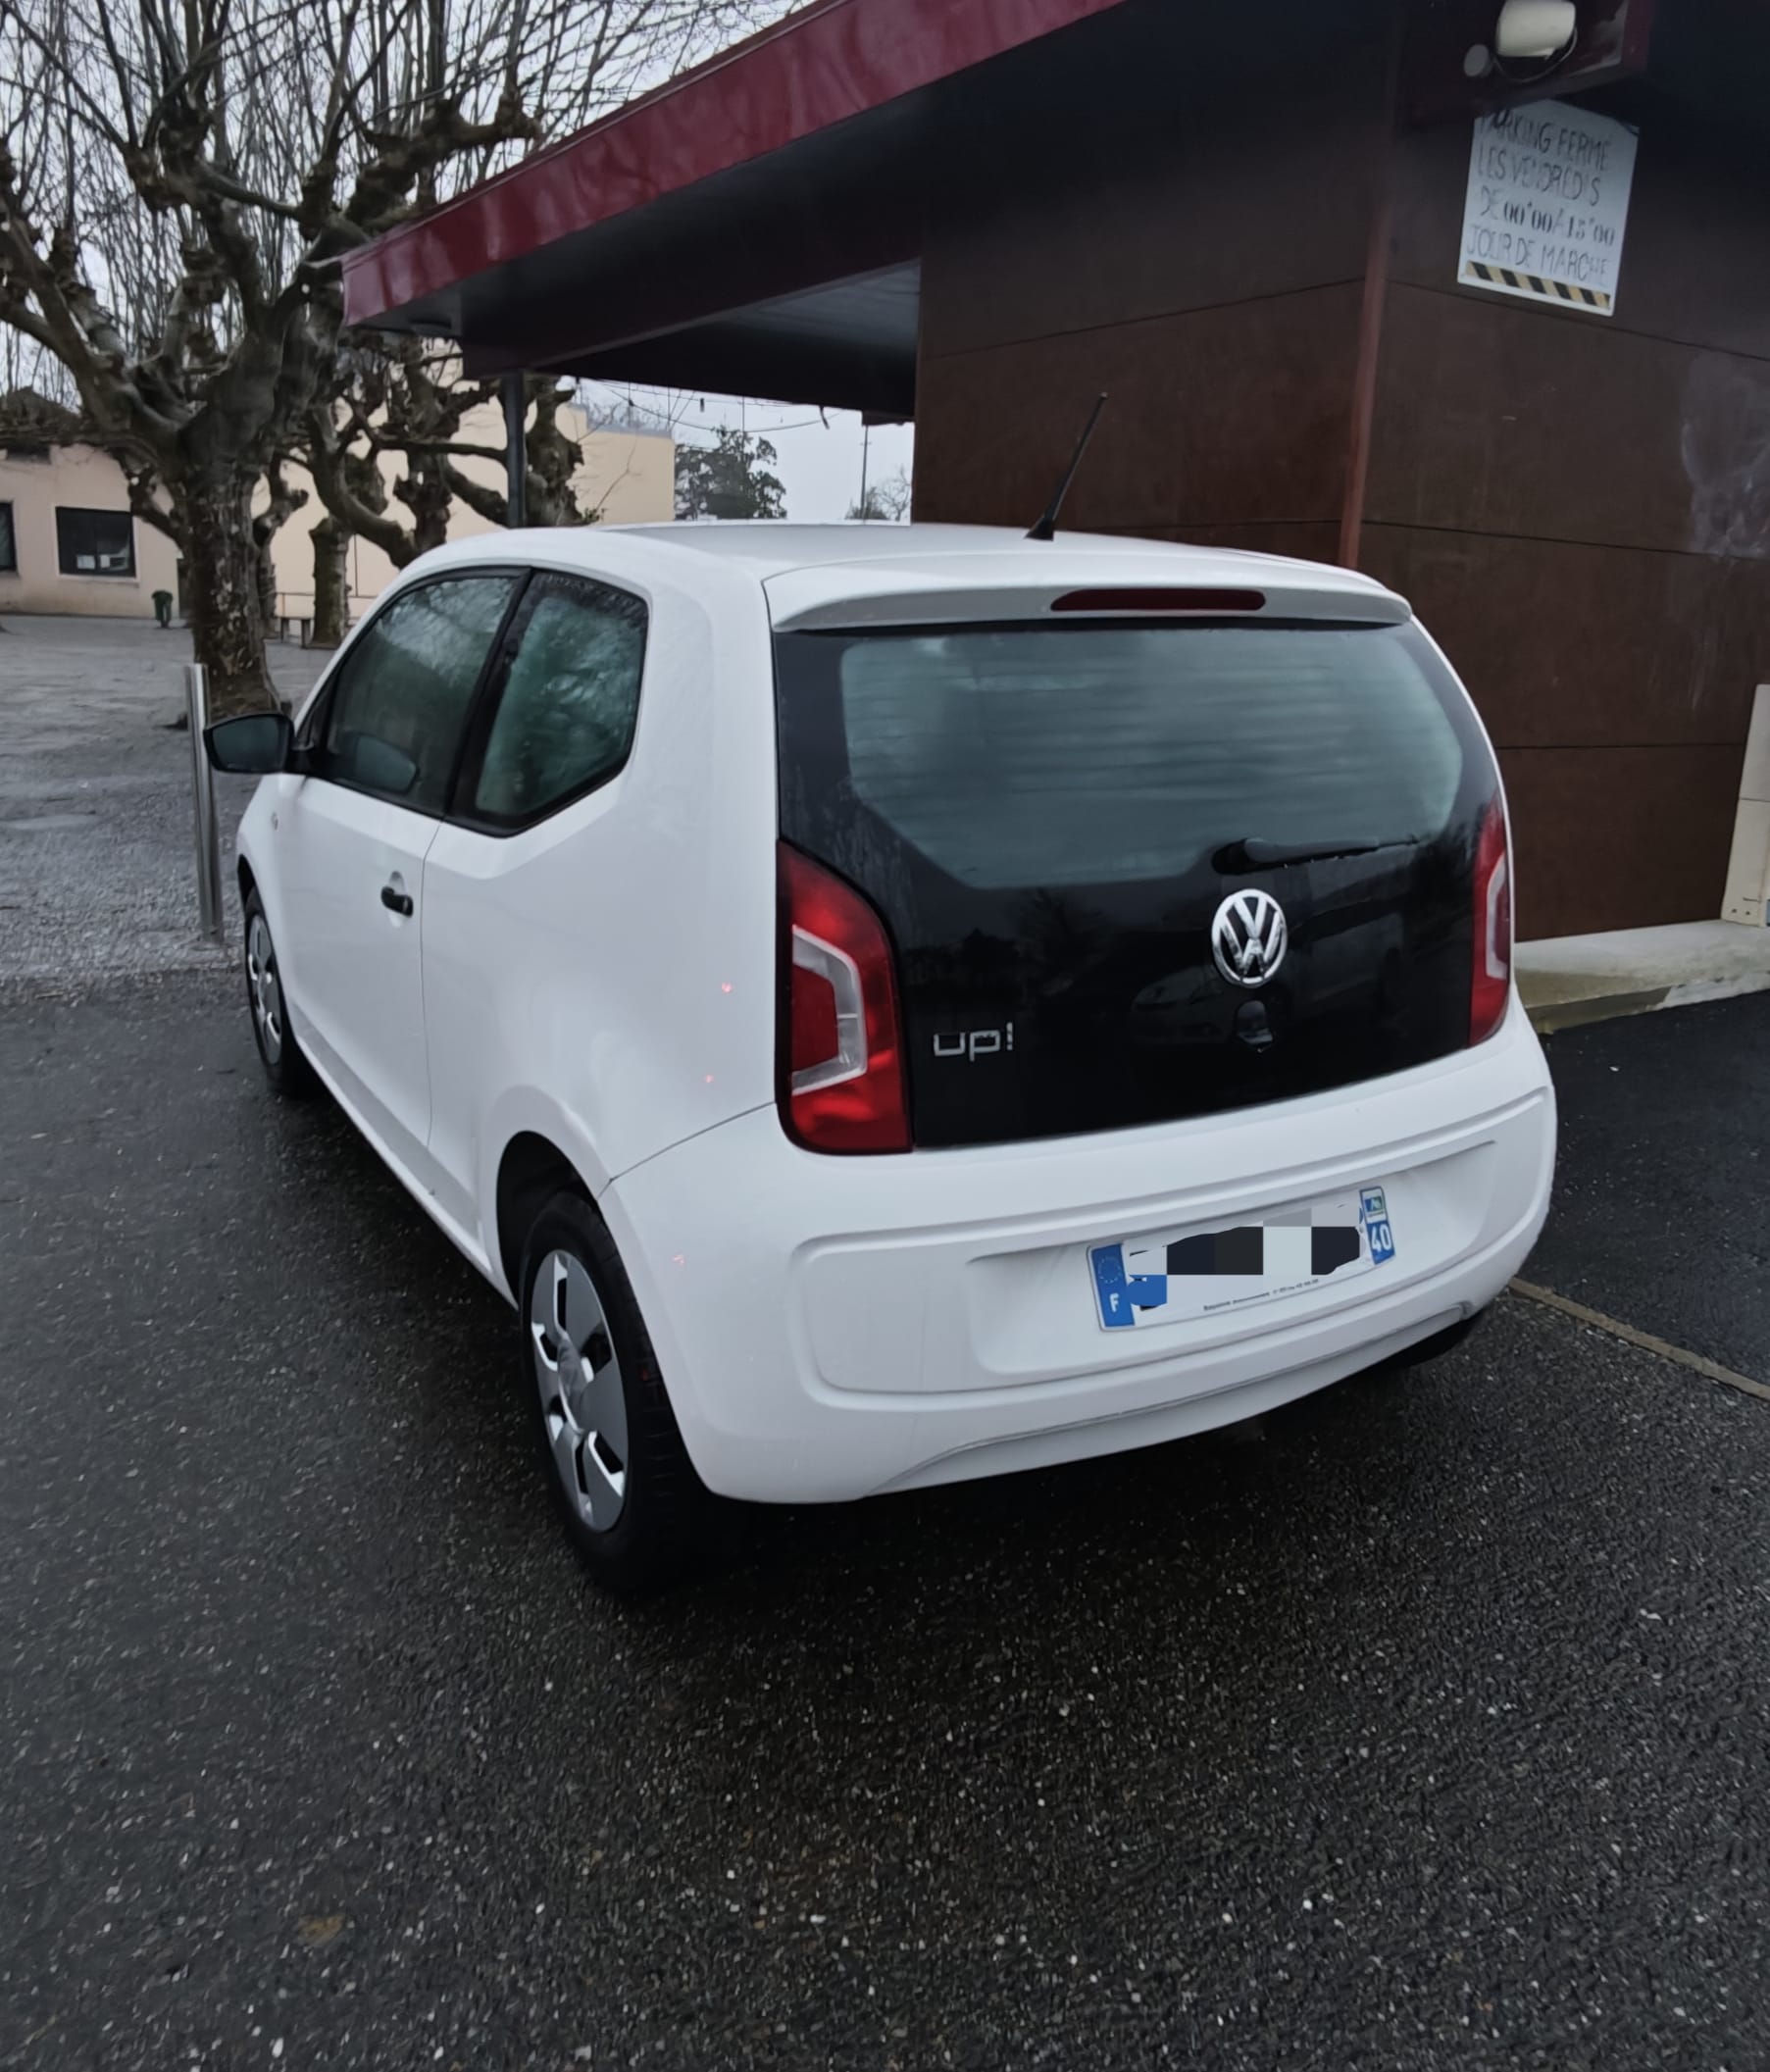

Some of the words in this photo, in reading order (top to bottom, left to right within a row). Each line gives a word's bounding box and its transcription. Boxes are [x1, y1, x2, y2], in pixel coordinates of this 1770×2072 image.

[1477, 143, 1507, 179] LES
[1479, 184, 1503, 220] DE
[1467, 225, 1512, 262] JOUR
[1515, 237, 1537, 267] DE
[934, 1022, 1014, 1061] up!
[1371, 1224, 1392, 1253] 40
[1109, 1293, 1120, 1313] F
